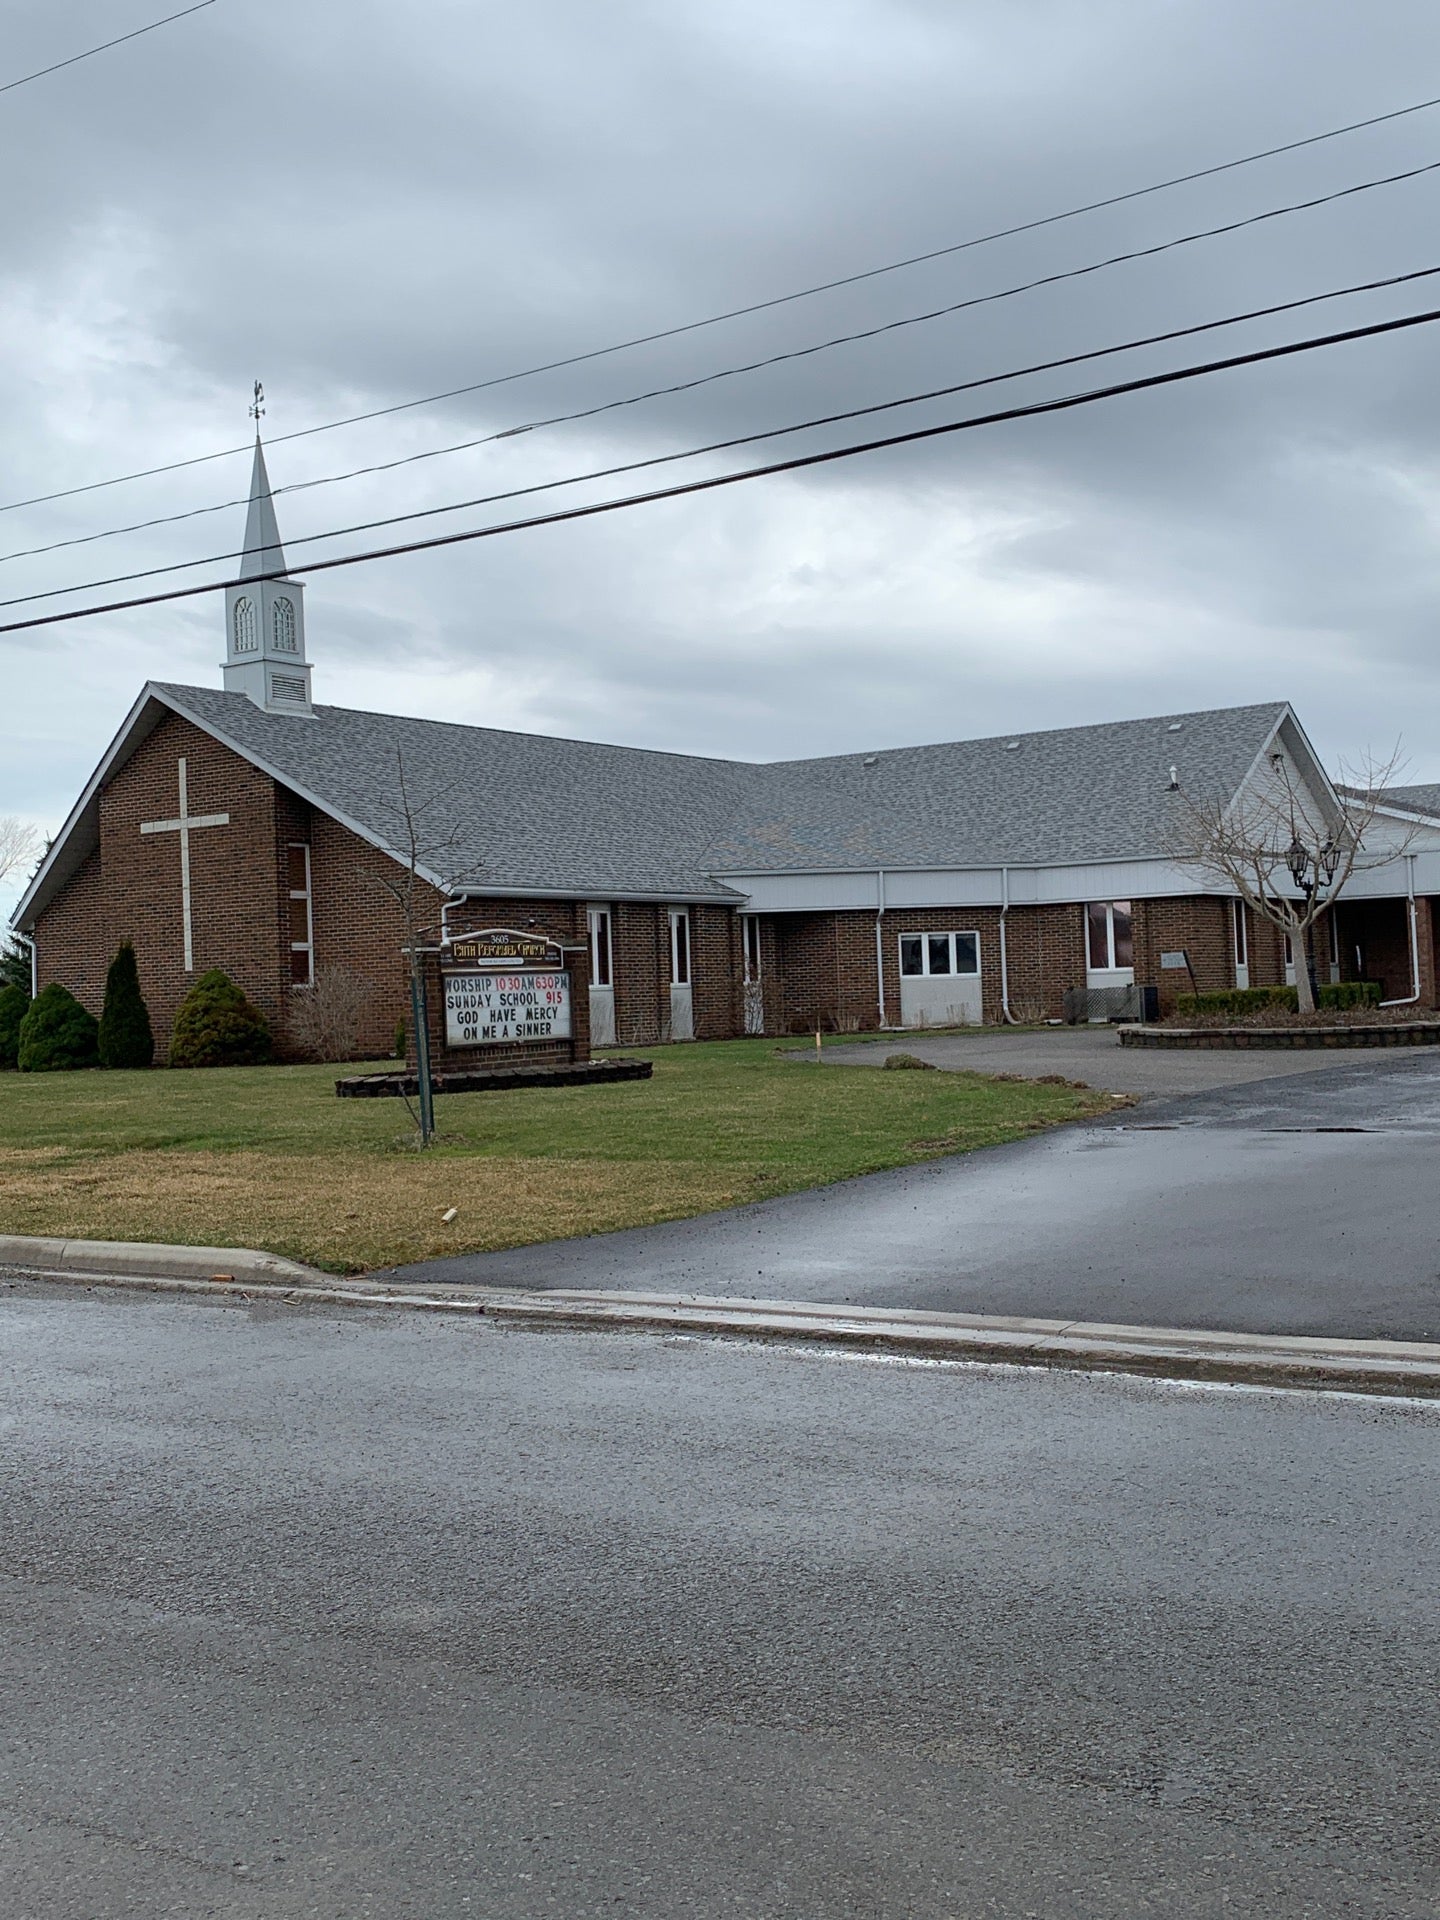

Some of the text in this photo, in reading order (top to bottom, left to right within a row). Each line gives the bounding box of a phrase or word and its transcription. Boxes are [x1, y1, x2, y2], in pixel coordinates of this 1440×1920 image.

[491, 935, 509, 944] 3605
[447, 991, 562, 1009] SUNDAY SCHOOL 915
[457, 1006, 558, 1024] GOD HAVE MERCY
[464, 1022, 551, 1040] ON ME A SINNER
